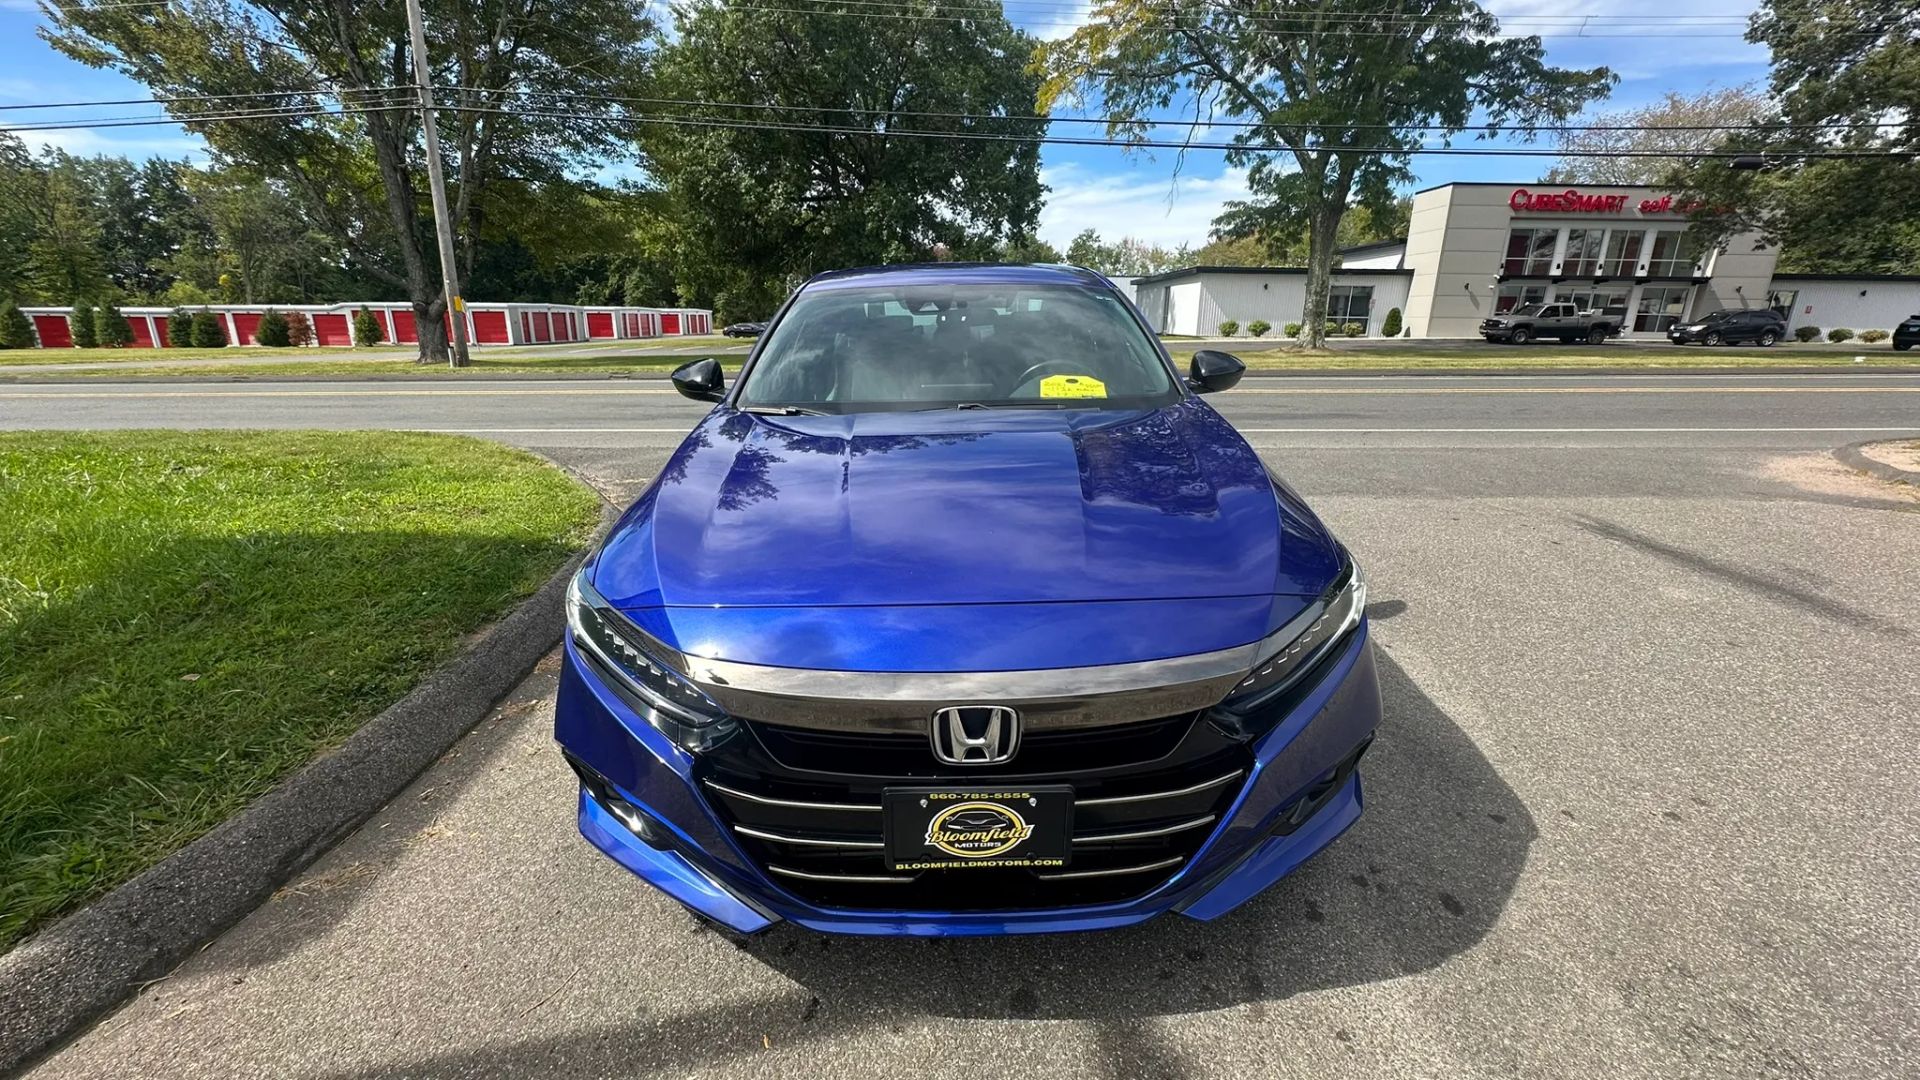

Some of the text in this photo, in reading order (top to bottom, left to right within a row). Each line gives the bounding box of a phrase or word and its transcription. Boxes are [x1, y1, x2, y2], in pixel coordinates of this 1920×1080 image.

[1639, 193, 1673, 212] self
[929, 792, 1031, 800] 860-785-5555
[929, 827, 1029, 843] Bloomfield
[895, 859, 1064, 871] BLOOMFIELDMOTORS.COM
